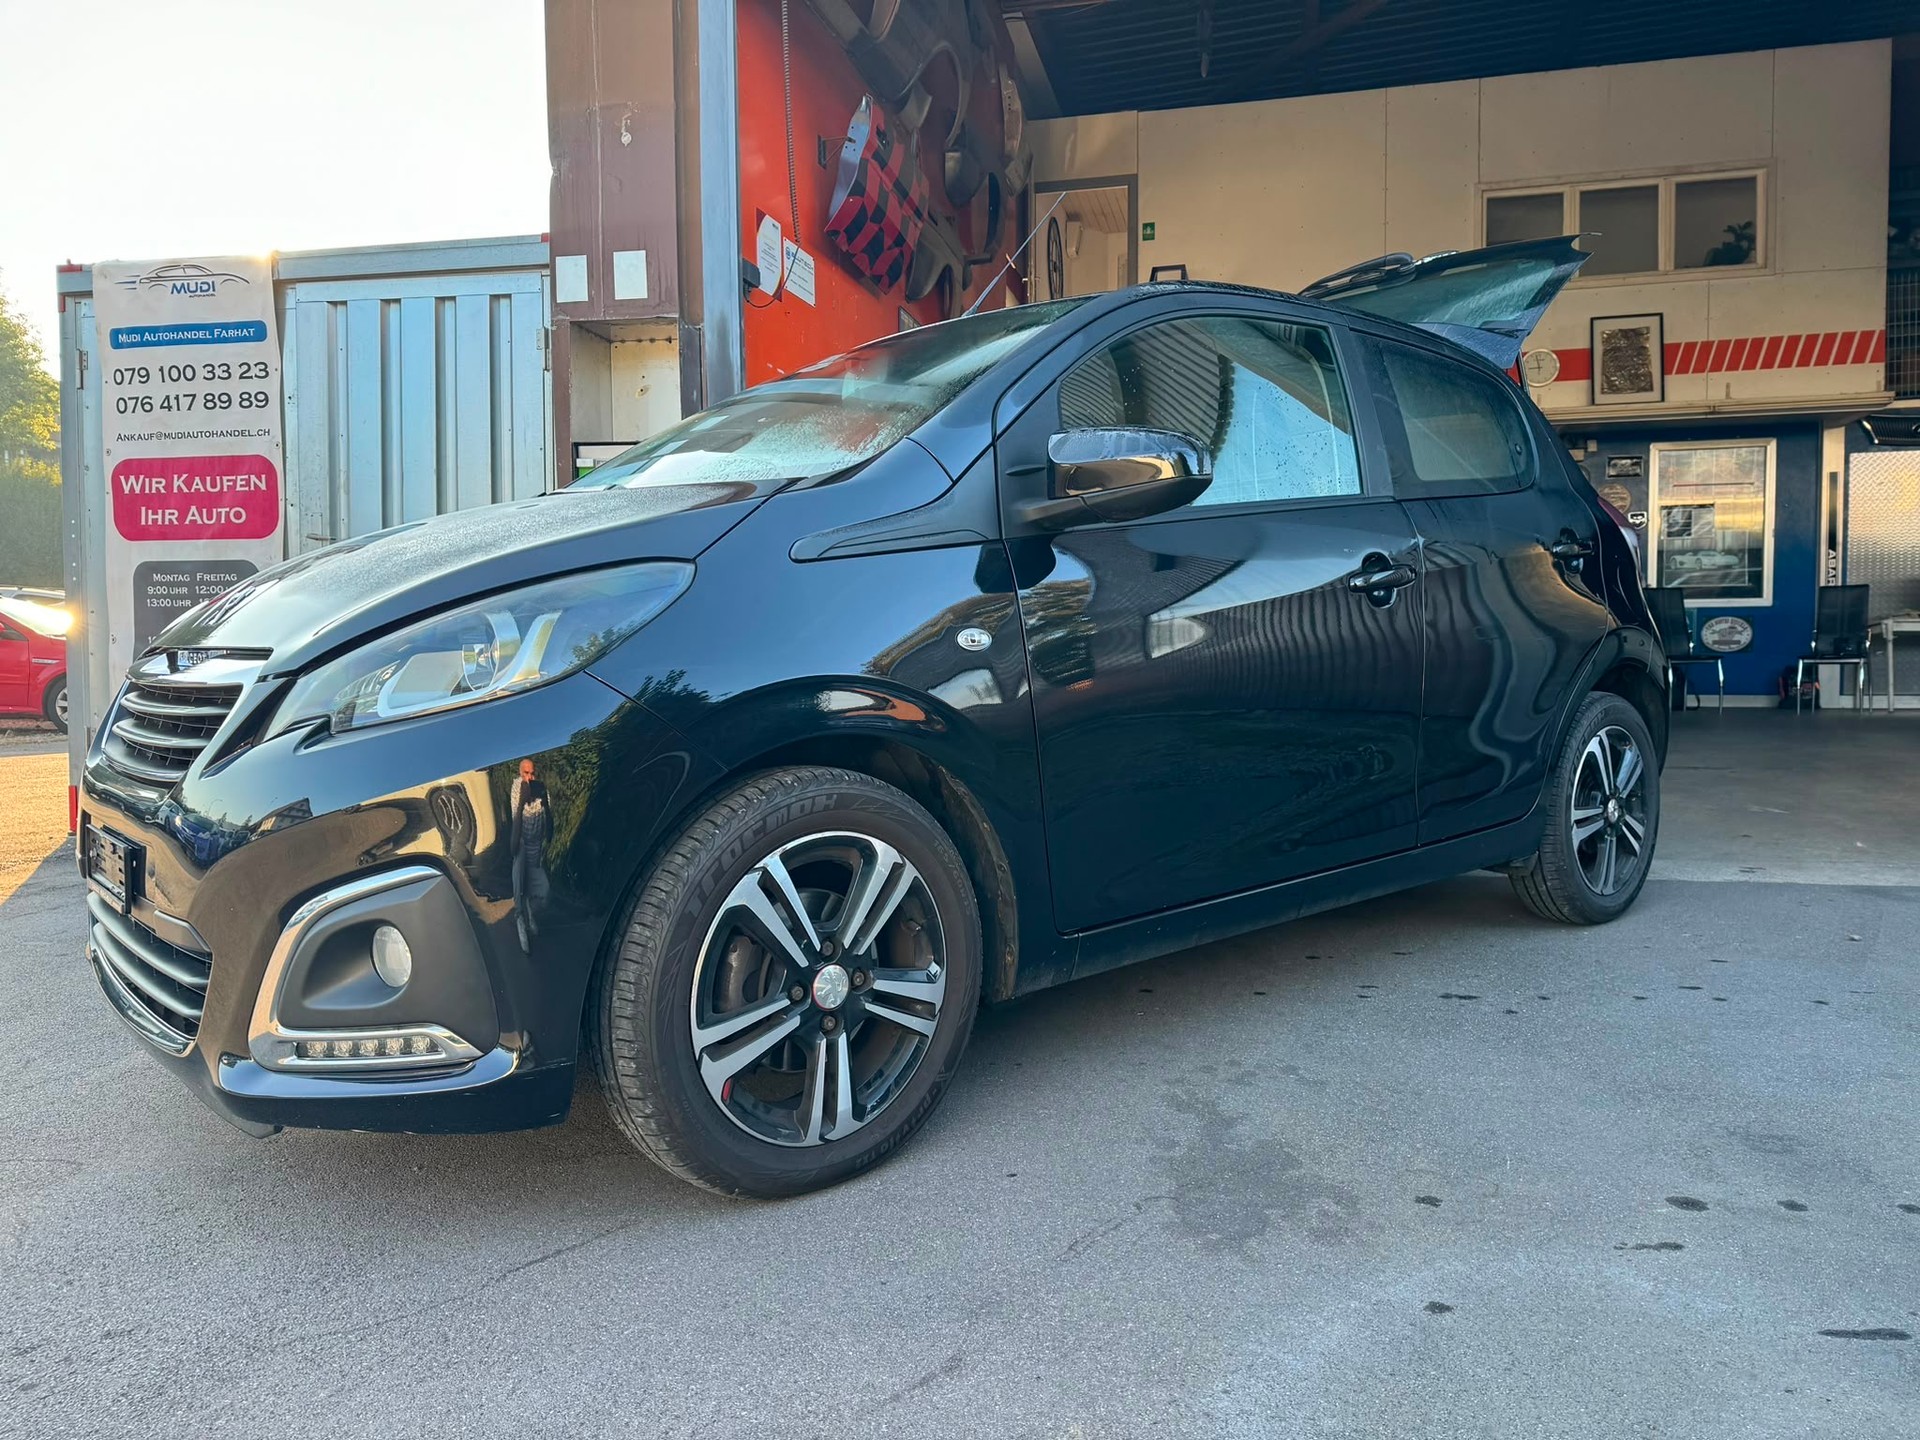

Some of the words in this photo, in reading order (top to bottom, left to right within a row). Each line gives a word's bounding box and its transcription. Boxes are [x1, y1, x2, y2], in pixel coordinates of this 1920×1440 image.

[170, 281, 216, 295] MUDI
[118, 333, 141, 344] MUDI
[143, 330, 212, 342] AUTOHANDEL
[214, 328, 255, 339] FARHAT
[113, 366, 150, 386] 079
[158, 364, 196, 384] 100
[202, 362, 232, 381] 33
[238, 361, 270, 380] 23
[116, 395, 154, 414] 076
[159, 393, 197, 412] 417
[203, 392, 232, 410] 89
[238, 391, 269, 409] 89
[119, 475, 166, 494] WIR
[173, 473, 267, 493] KAUFEN
[140, 506, 179, 526] IHR
[184, 505, 246, 525] AUTO
[152, 573, 190, 582] MONTAG
[196, 572, 238, 581] FREITAG
[147, 586, 168, 595] 9:00
[169, 586, 188, 595] UHR
[195, 585, 224, 594] 12:00
[147, 598, 172, 607] 13:00
[173, 599, 192, 607] UHR
